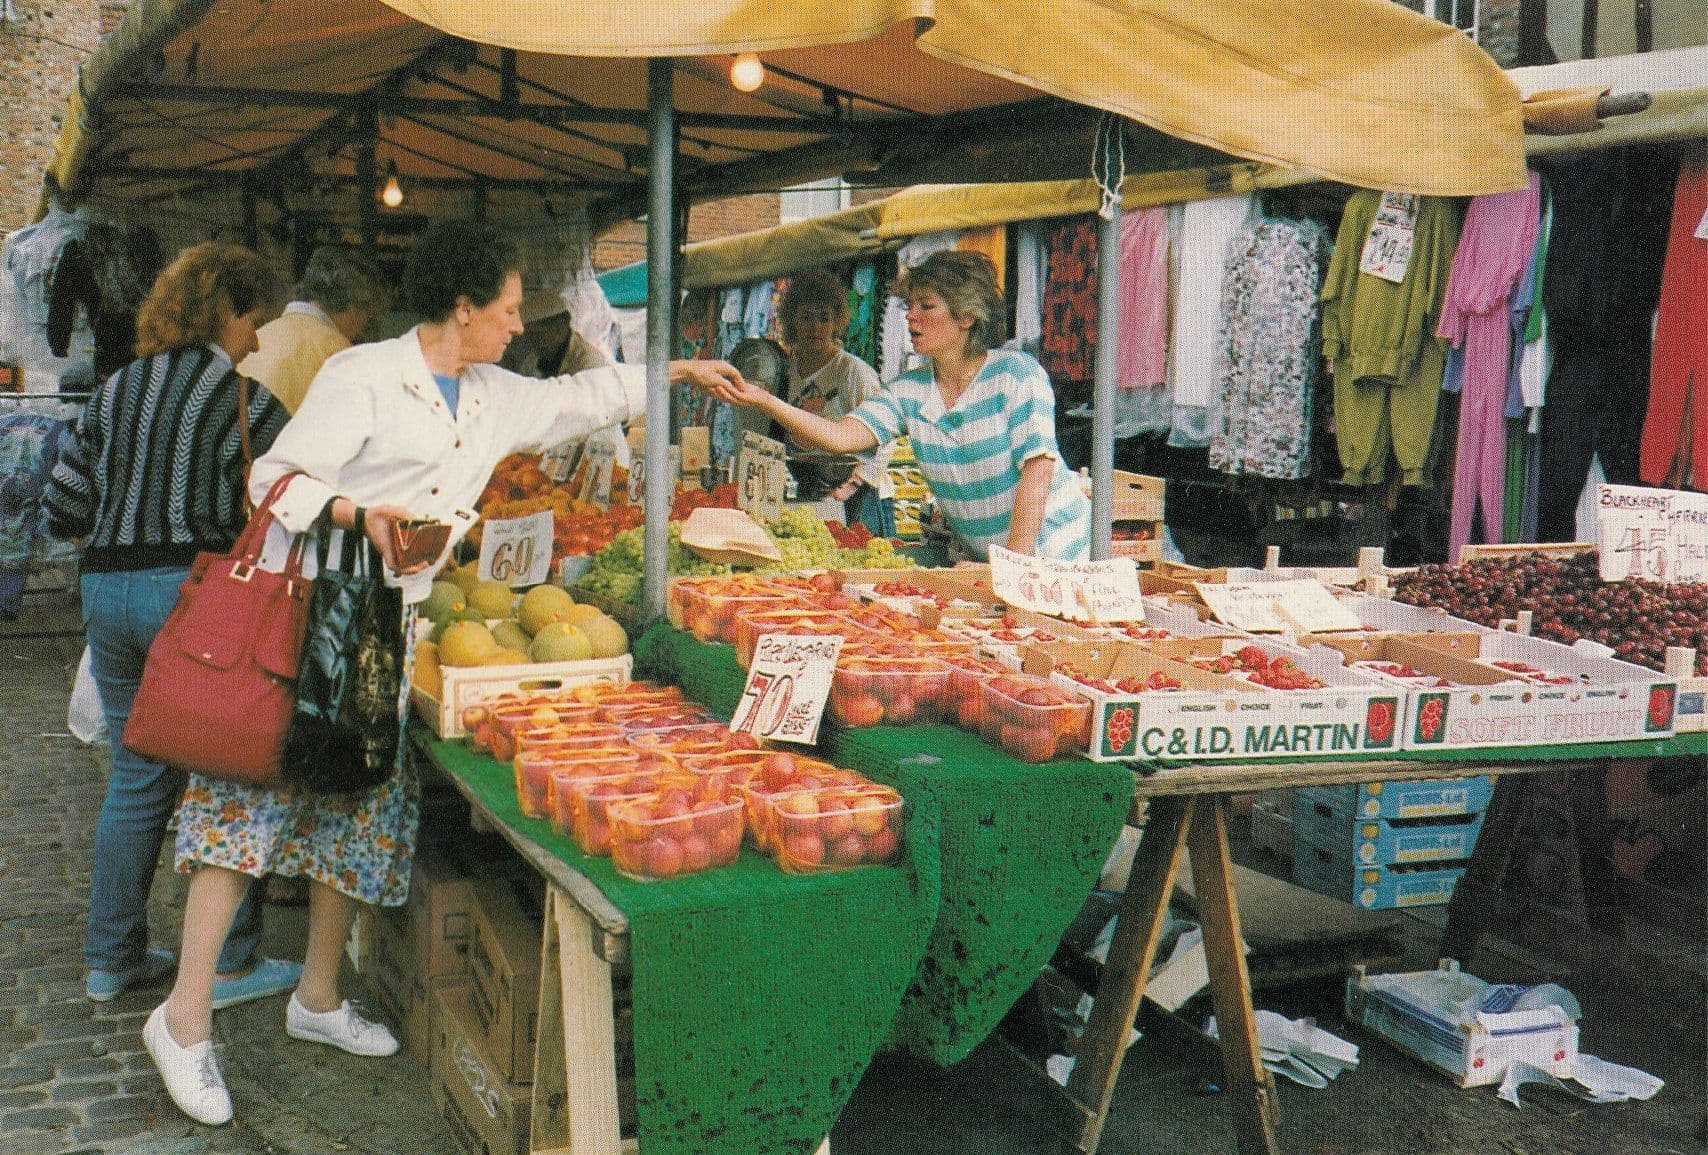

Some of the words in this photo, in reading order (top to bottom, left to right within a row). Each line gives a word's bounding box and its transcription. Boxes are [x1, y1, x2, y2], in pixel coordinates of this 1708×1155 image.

[490, 535, 535, 582] 60
[735, 670, 794, 737] 70
[1180, 704, 1217, 712] ENGLISH
[1240, 703, 1271, 711] CHOICE
[1244, 723, 1360, 752] MARTIN
[1449, 714, 1535, 744] SOFT
[1542, 709, 1642, 740] FRUIT
